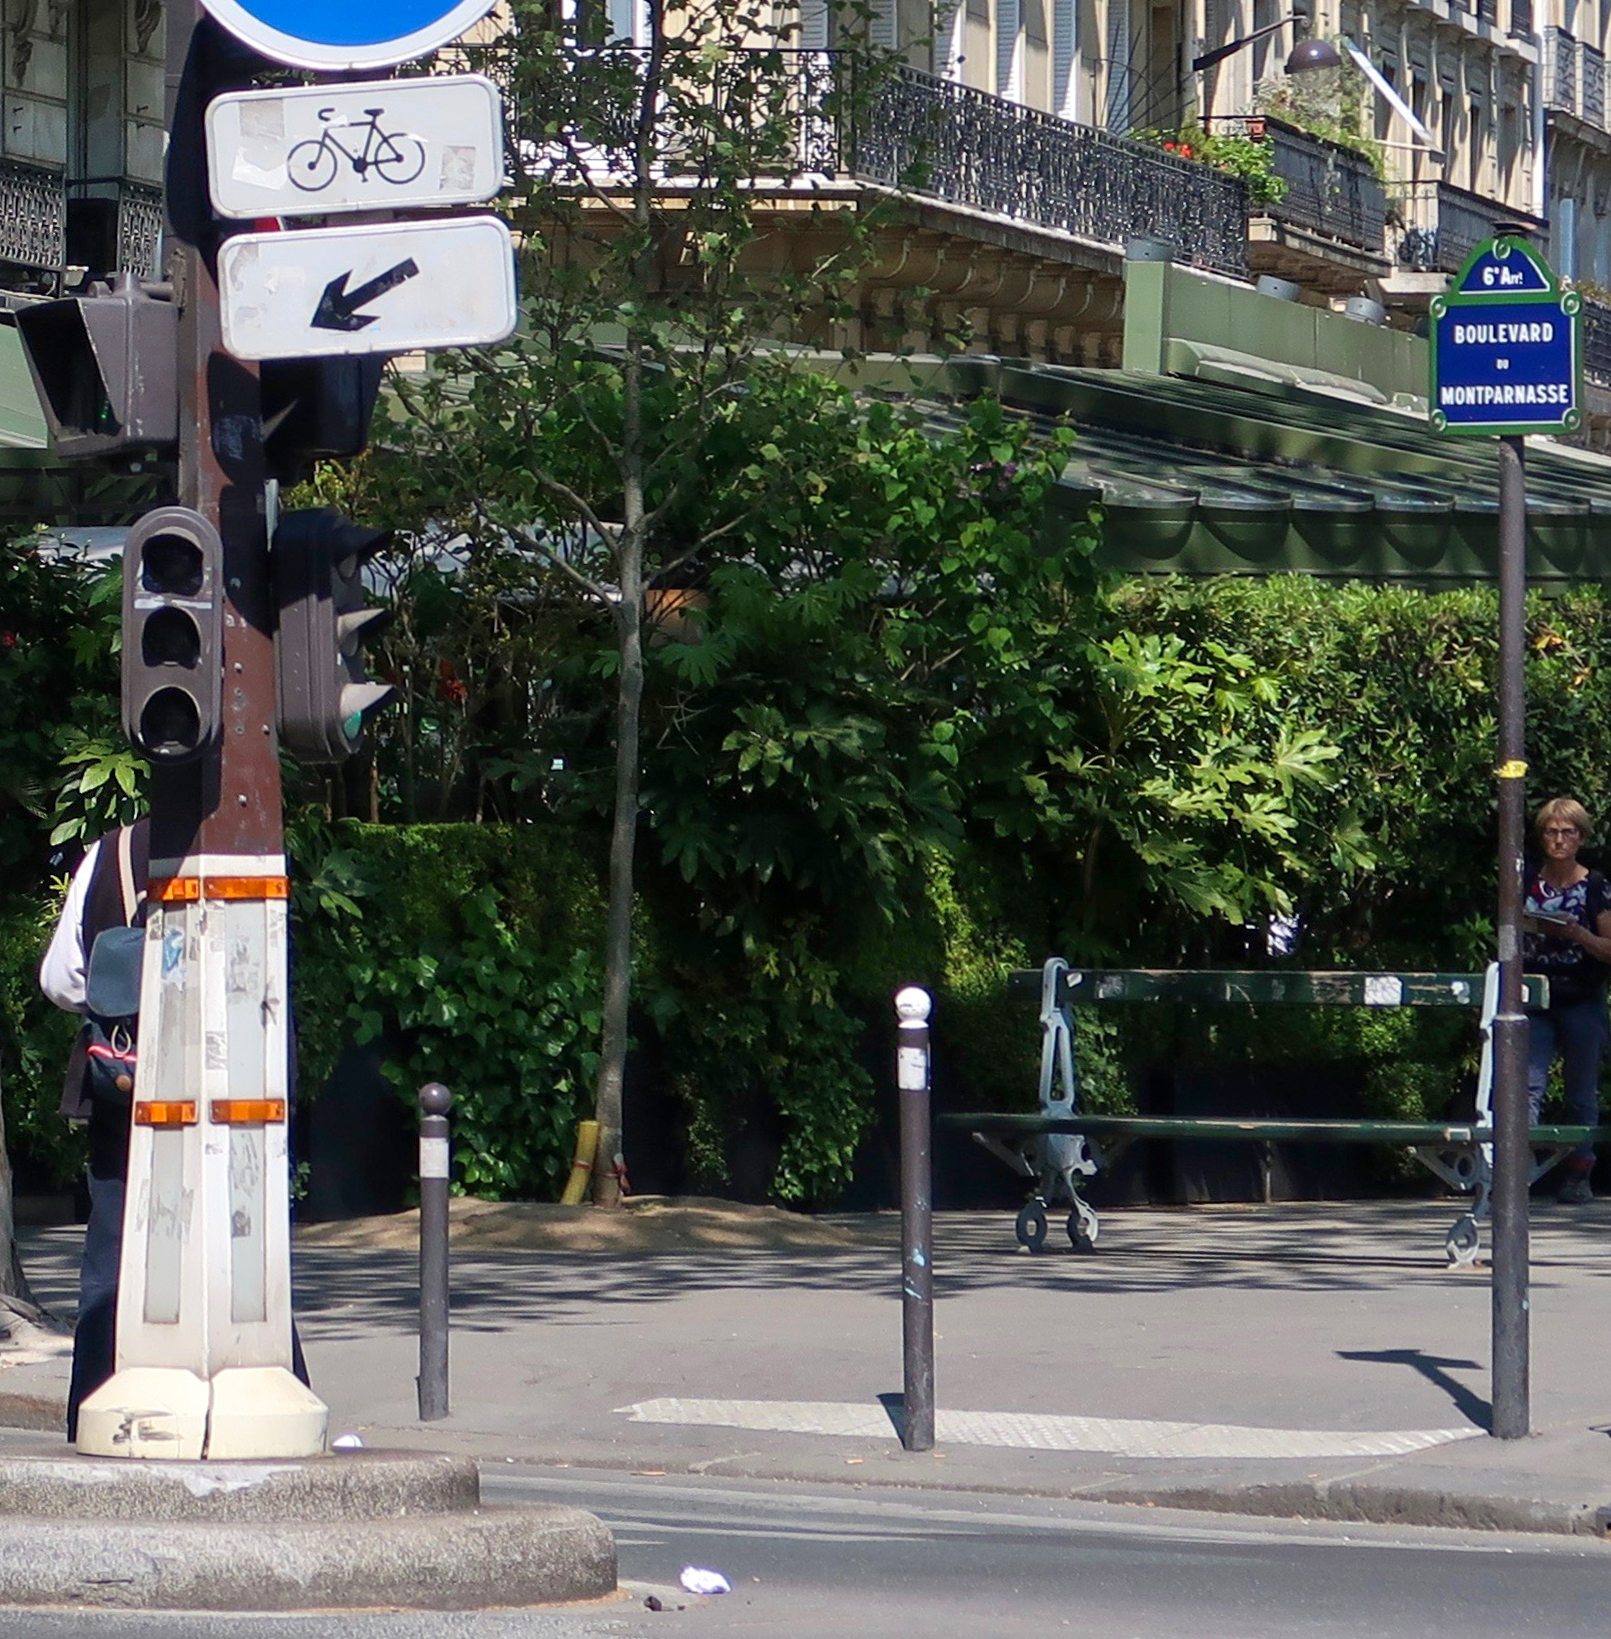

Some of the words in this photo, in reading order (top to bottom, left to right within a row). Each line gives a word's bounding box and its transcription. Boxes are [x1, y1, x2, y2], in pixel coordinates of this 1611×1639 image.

[1453, 322, 1554, 345] BOULEVARD
[1496, 358, 1510, 370] DU
[1441, 383, 1570, 406] MONTPARNASSE
